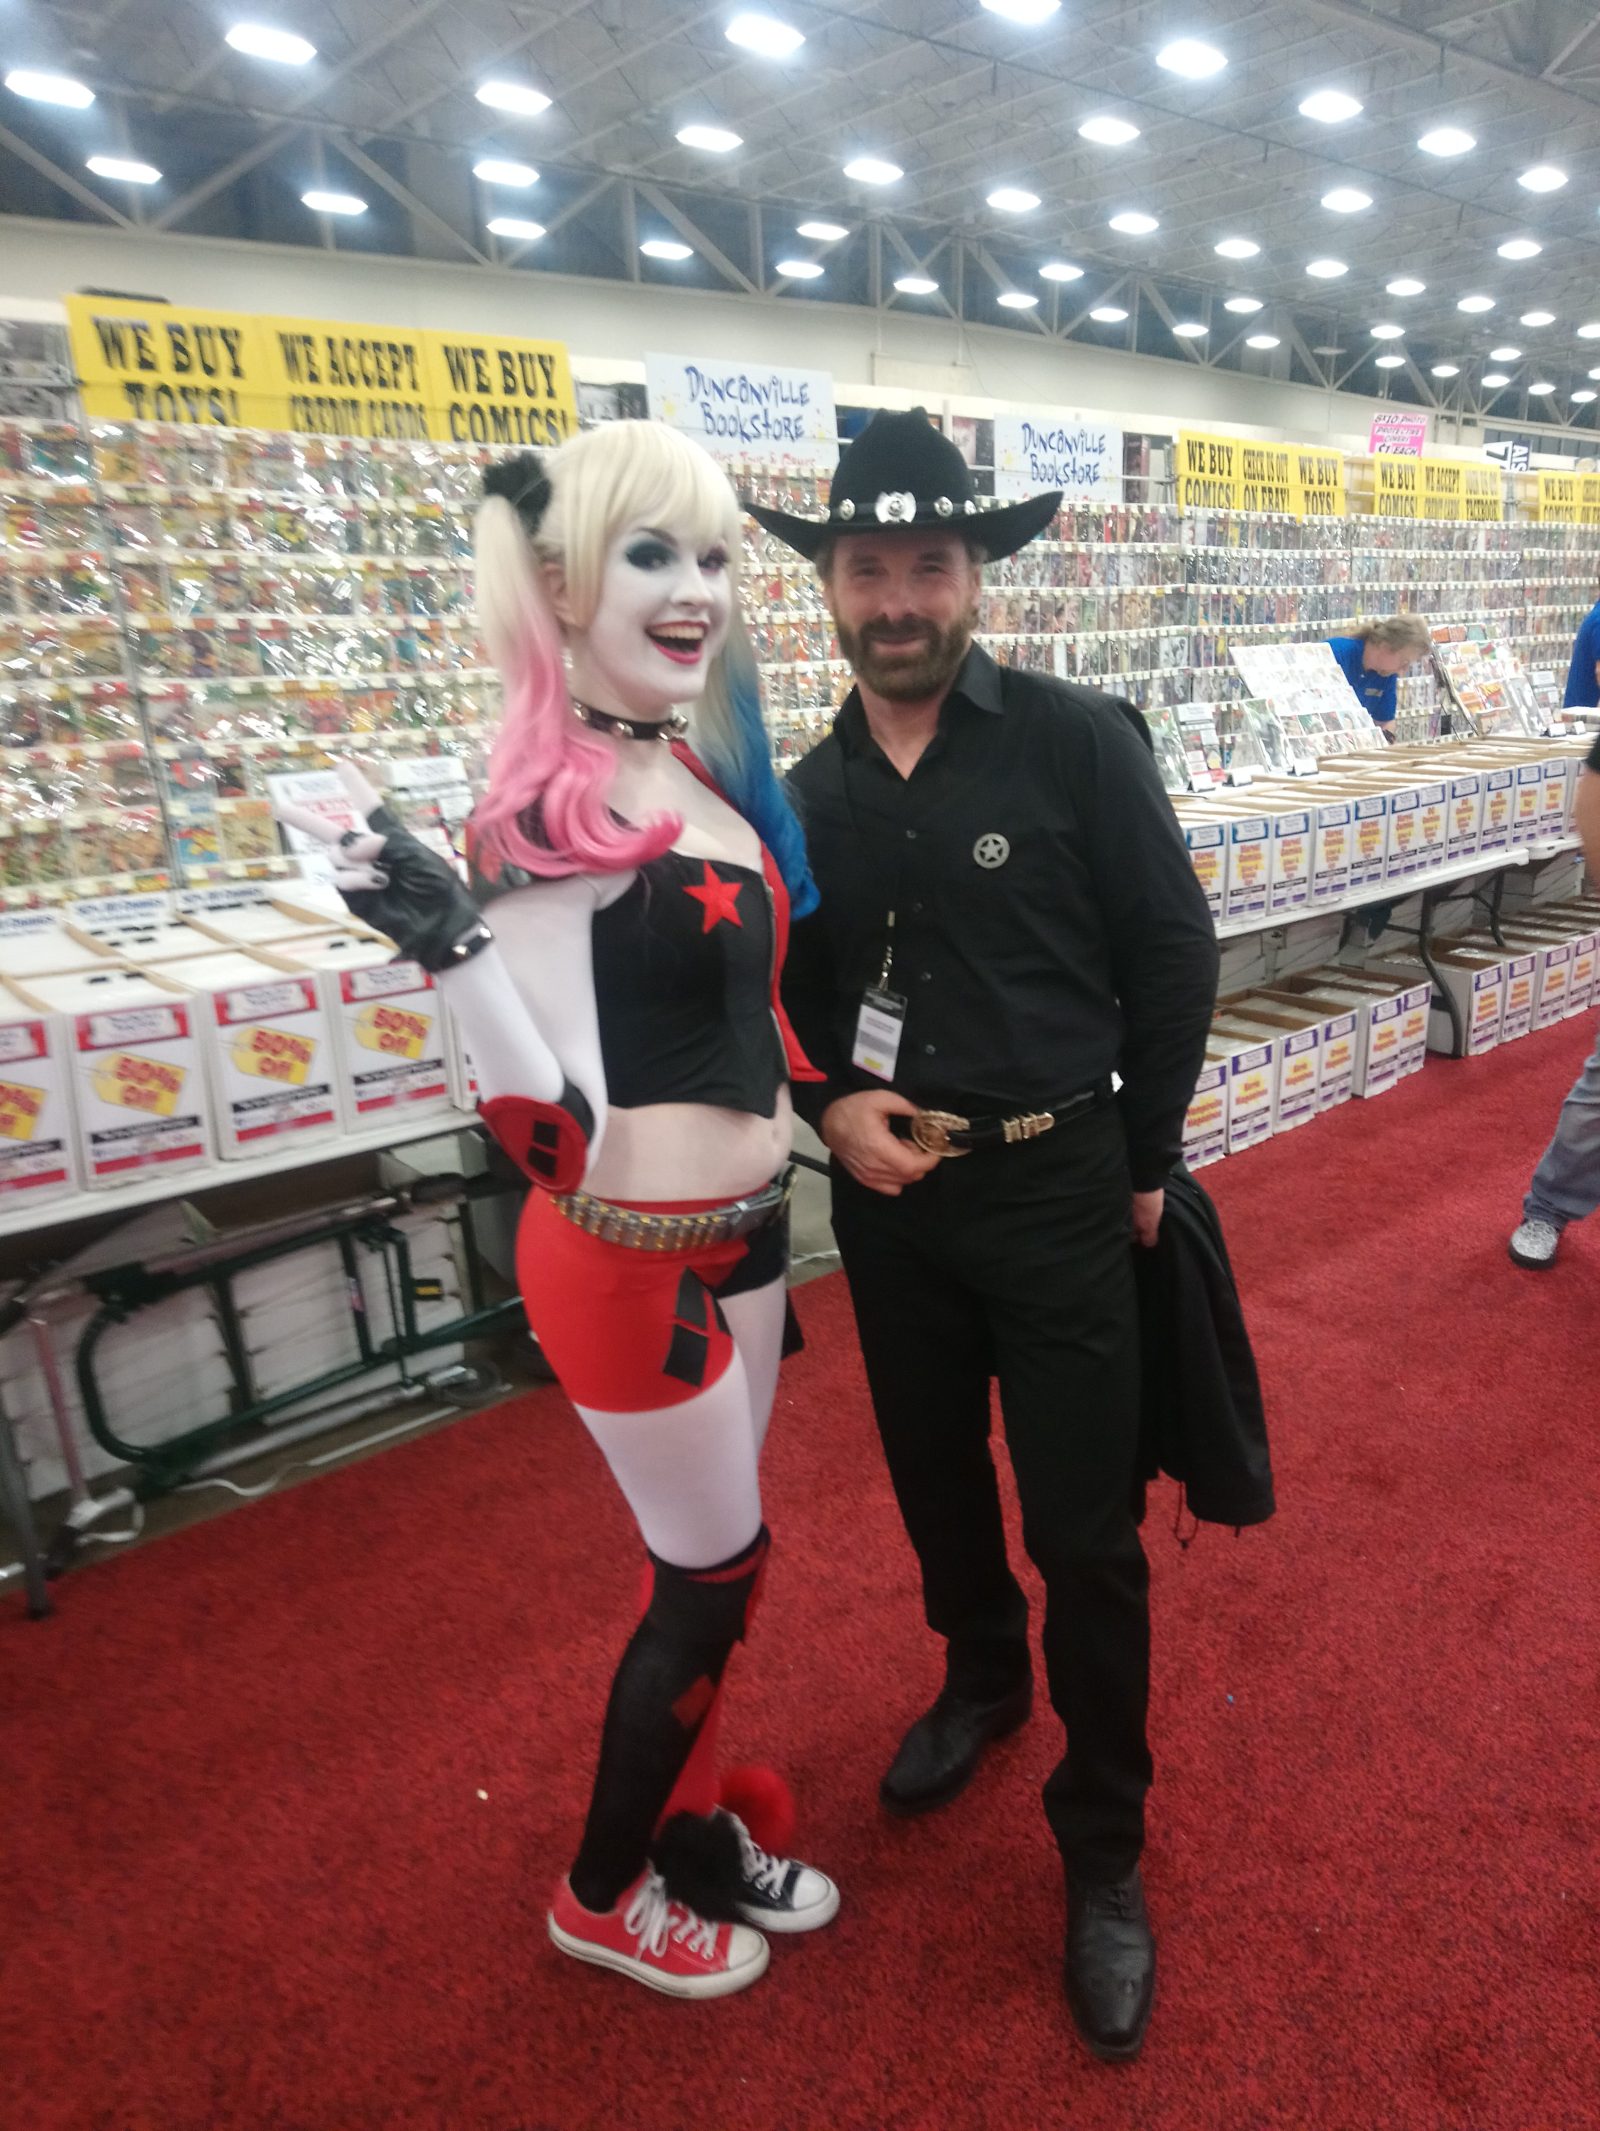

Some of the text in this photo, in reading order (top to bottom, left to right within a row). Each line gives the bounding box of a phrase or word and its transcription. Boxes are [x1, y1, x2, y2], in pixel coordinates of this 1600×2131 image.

[92, 315, 245, 379] WE BUY
[277, 331, 420, 392] WE ACCEPT
[442, 344, 558, 399] WE BUY
[1186, 439, 1233, 478] WE BUY
[1243, 448, 1289, 484] CHECK US OUT
[1298, 455, 1339, 487] WE BUY
[1380, 460, 1416, 491] WE BUY
[1425, 465, 1461, 495] WE ACCEPT
[1543, 477, 1557, 501] WE
[1558, 478, 1575, 502] BUY
[1185, 477, 1236, 511] COMICS!
[1243, 484, 1258, 513] ON
[1304, 489, 1337, 517] TOYS!
